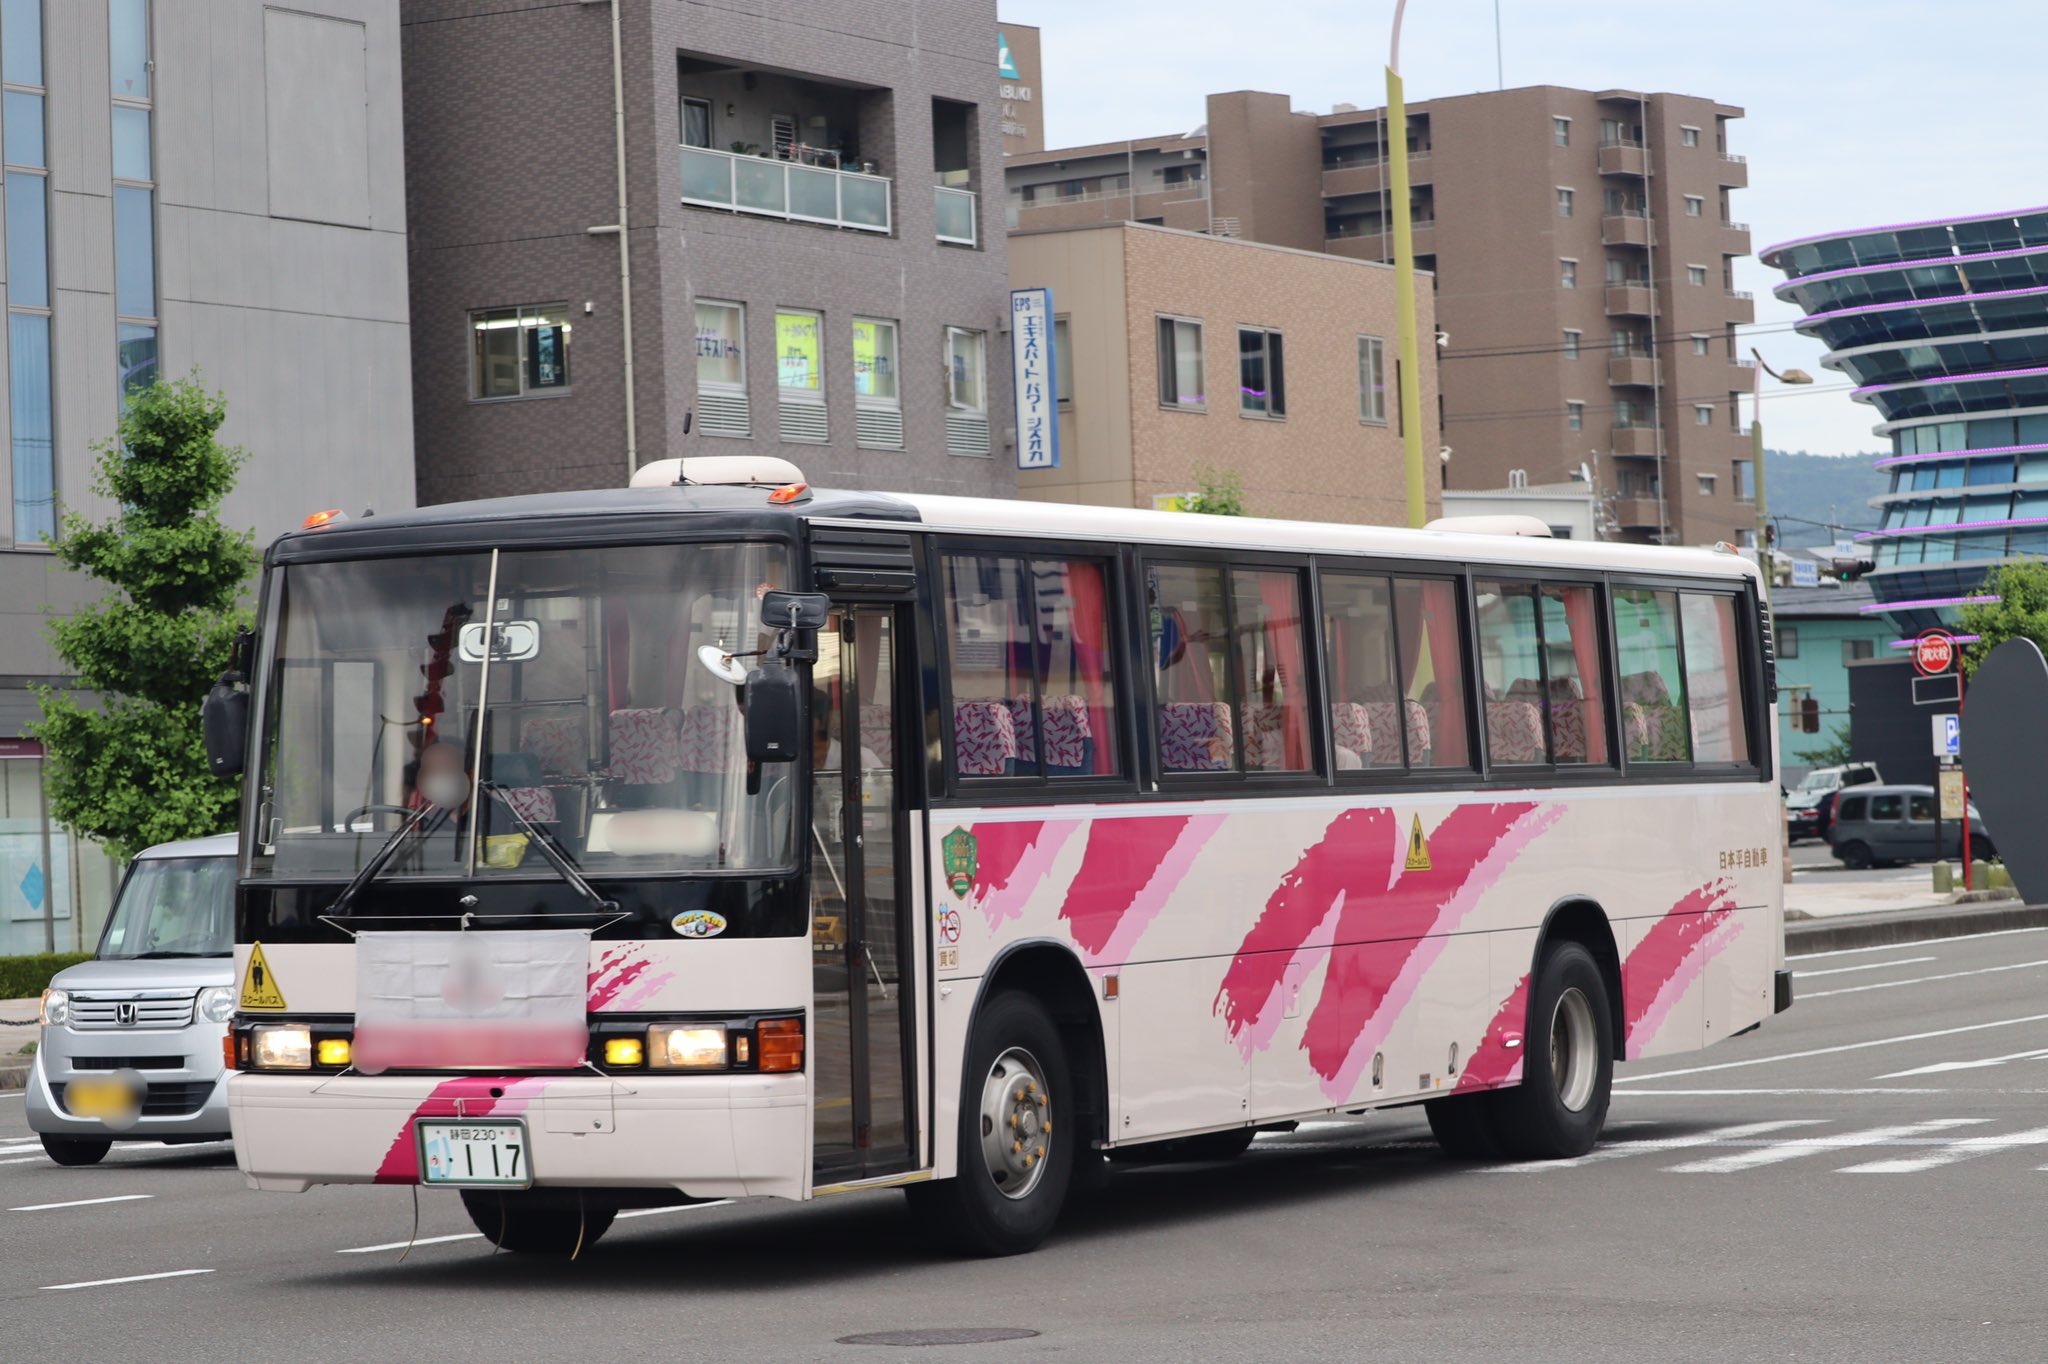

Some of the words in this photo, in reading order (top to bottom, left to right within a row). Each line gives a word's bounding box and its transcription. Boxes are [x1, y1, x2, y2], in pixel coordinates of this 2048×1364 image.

[1014, 297, 1031, 312] EPS
[1022, 315, 1040, 379] エキスパート
[1026, 383, 1041, 413] パワー
[1719, 847, 1768, 870] 日本平自動車
[242, 995, 279, 1005] スクールバス
